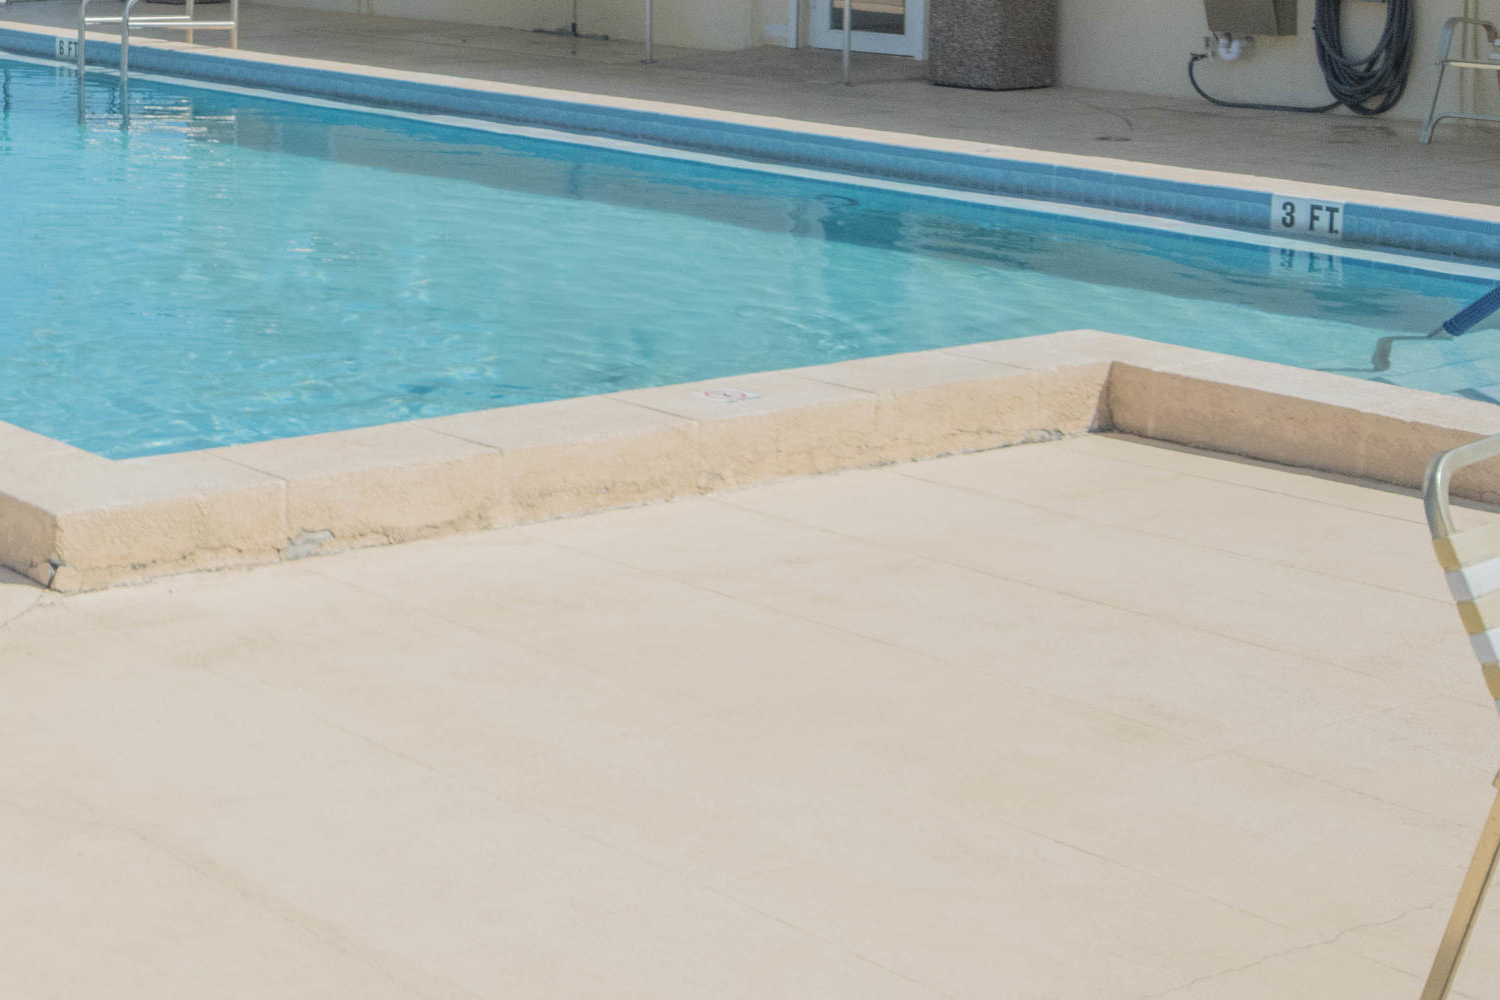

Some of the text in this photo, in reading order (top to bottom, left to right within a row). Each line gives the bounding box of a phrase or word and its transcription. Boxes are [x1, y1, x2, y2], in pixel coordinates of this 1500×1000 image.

[59, 40, 64, 56] 6
[1282, 201, 1340, 234] 3 FT.
